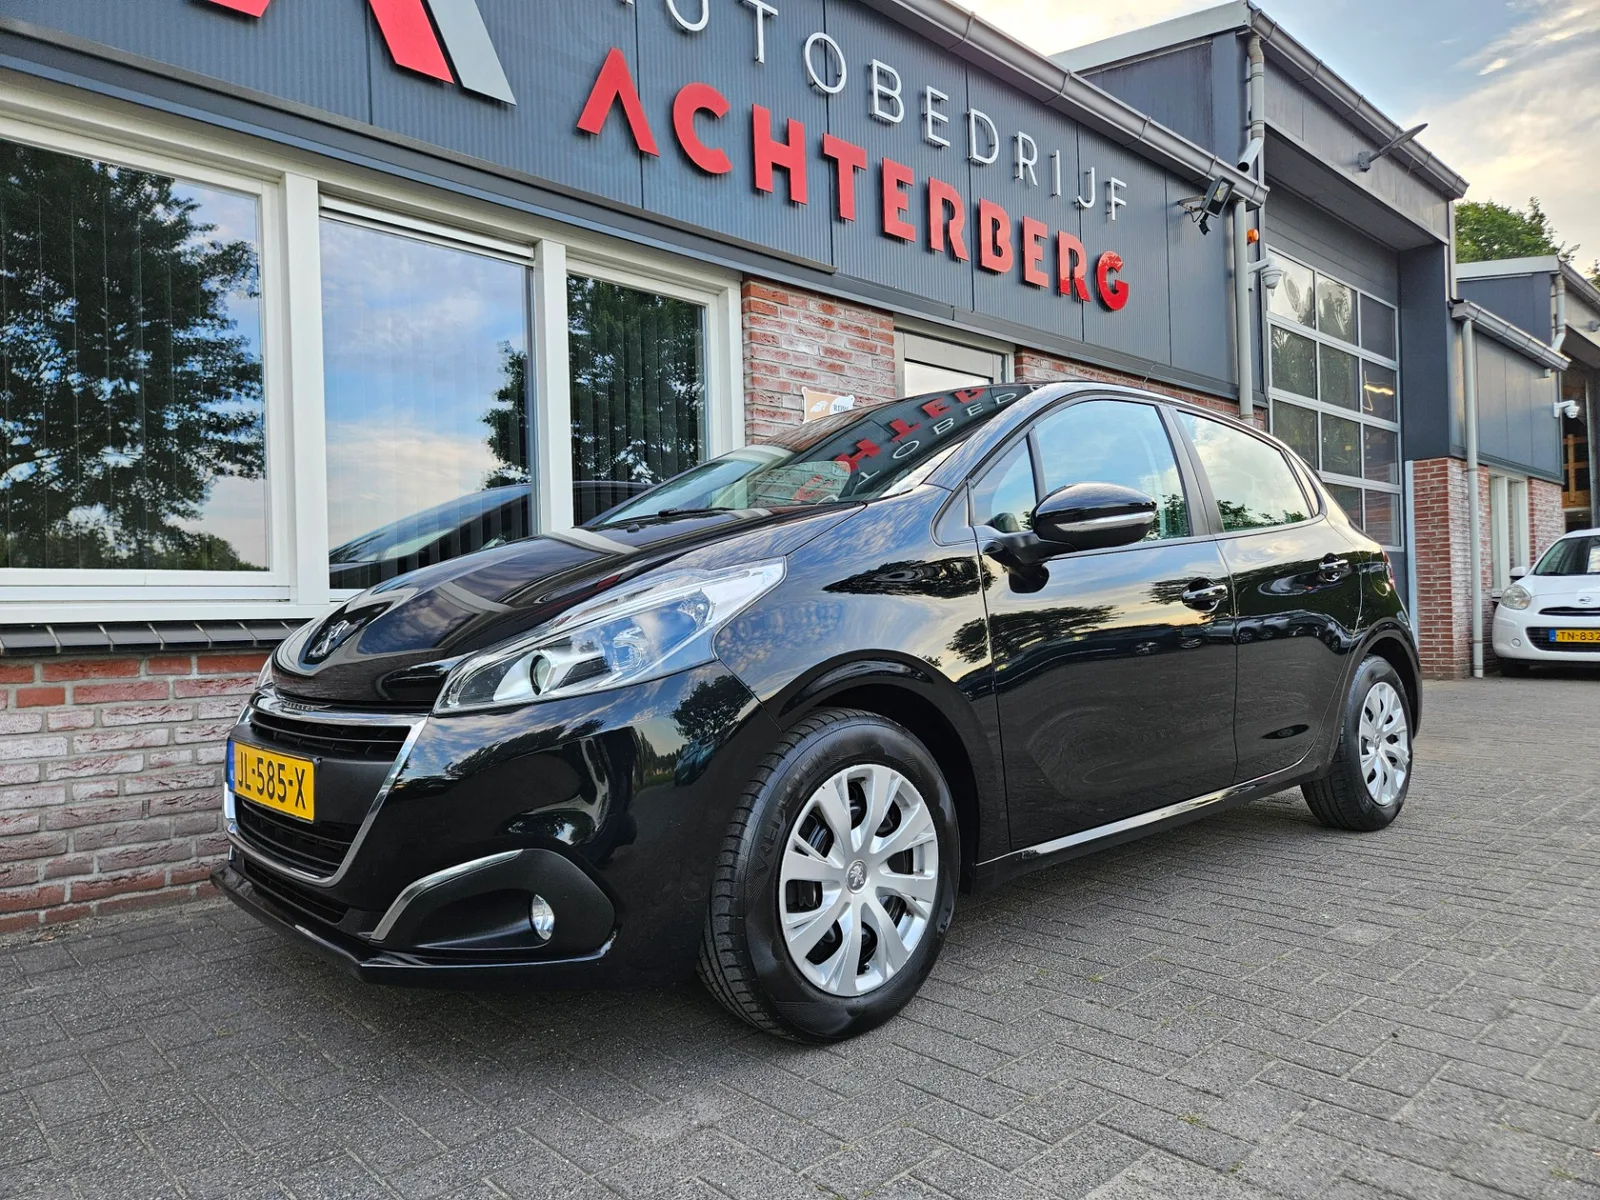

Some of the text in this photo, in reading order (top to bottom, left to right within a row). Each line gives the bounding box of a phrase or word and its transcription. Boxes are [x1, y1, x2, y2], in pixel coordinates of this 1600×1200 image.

[576, 47, 1130, 311] ACHTERBERG
[618, 0, 1128, 221] UTOBEDRIJF
[1560, 631, 1600, 641] TN-832
[238, 751, 306, 810] JL-585-X
